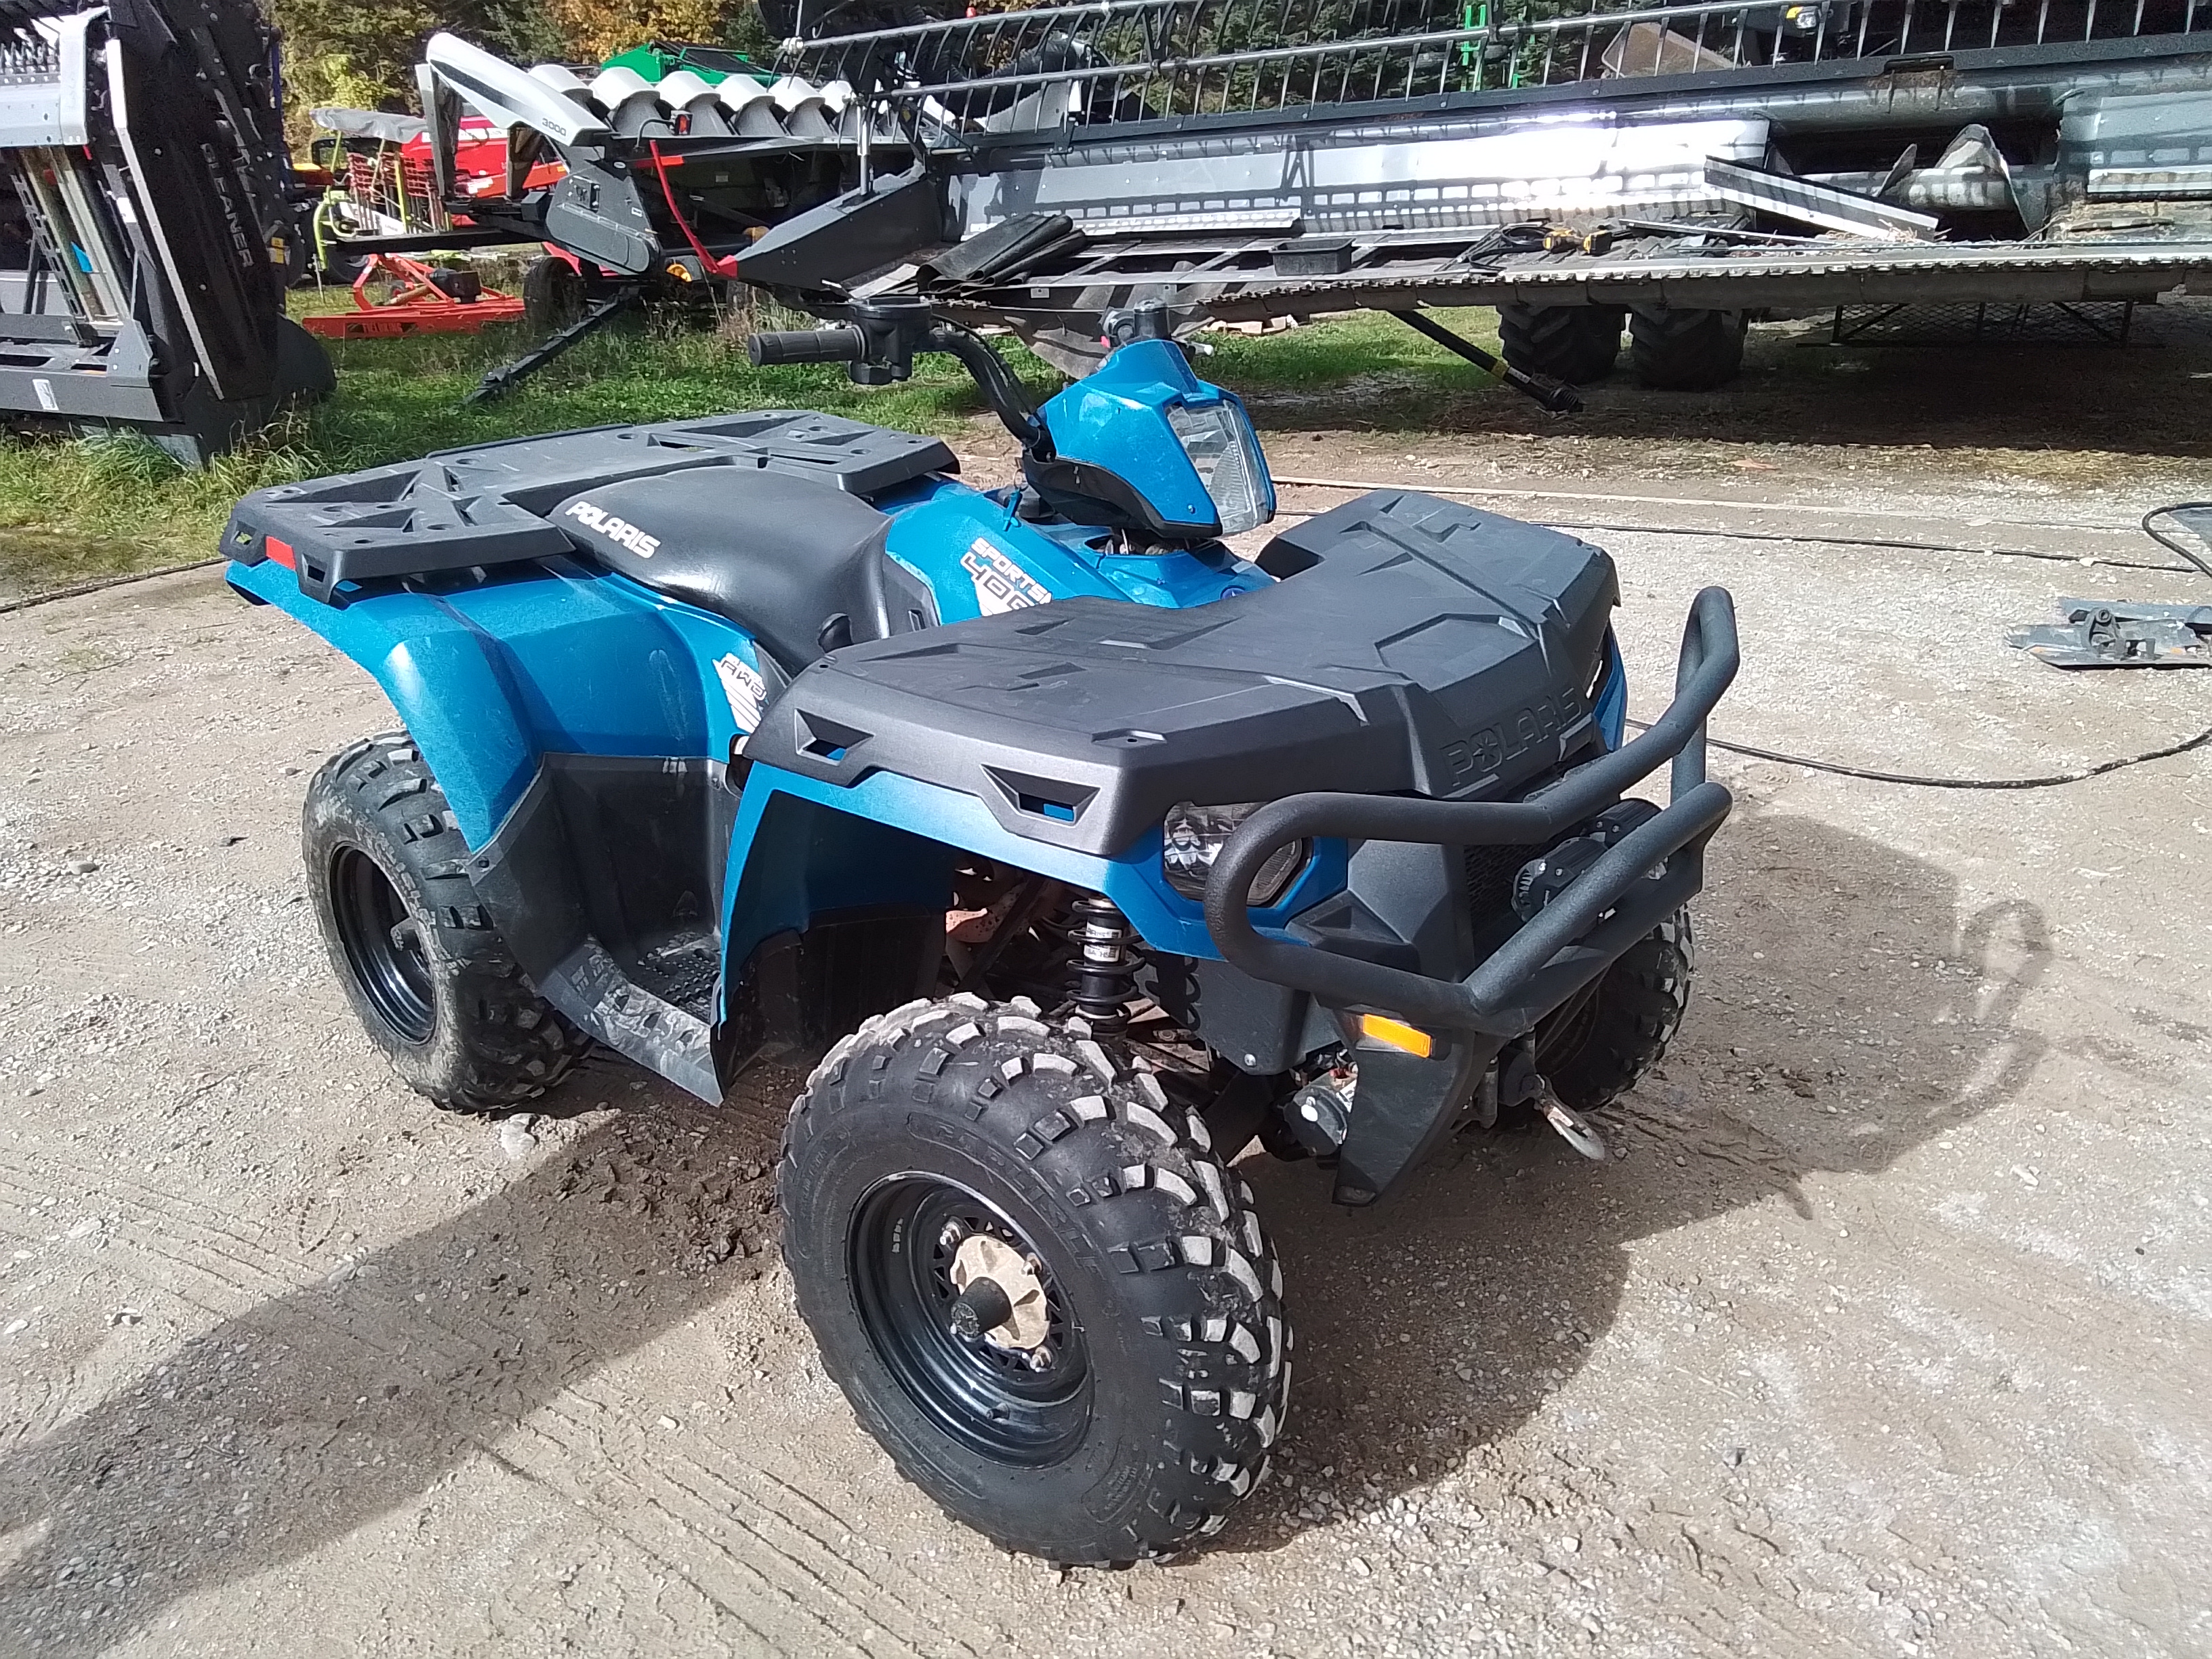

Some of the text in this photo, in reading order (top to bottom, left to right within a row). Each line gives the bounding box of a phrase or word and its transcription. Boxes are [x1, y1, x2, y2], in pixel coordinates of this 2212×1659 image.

[541, 117, 567, 137] 3000
[200, 143, 254, 267] GLEANER
[565, 501, 661, 558] POLARIS
[720, 659, 766, 698] AWD
[1439, 687, 1582, 786] POLARIS
